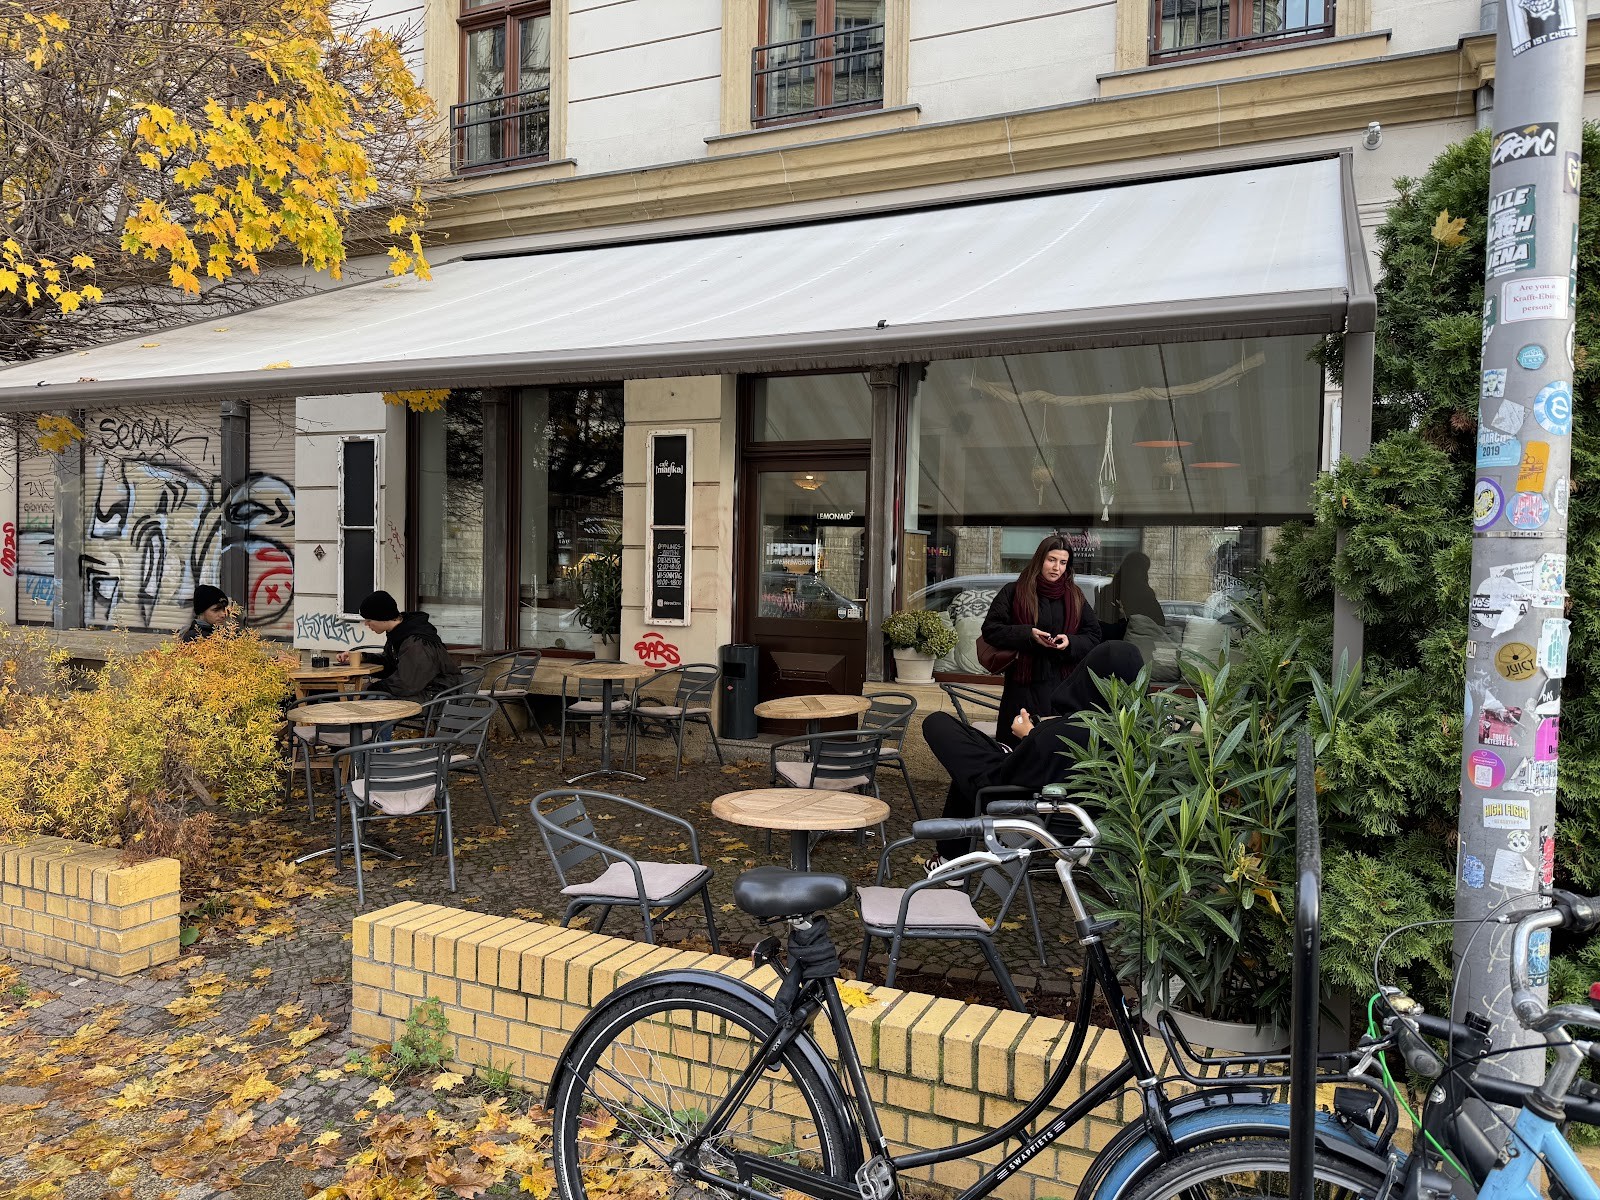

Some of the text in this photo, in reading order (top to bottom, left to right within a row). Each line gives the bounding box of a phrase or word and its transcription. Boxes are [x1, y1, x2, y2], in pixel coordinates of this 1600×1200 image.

[1513, 41, 1531, 56] HIER
[1533, 35, 1547, 45] IST
[1487, 243, 1529, 271] JENA
[1522, 304, 1552, 313] person?
[1482, 445, 1500, 457] 2019
[1543, 691, 1553, 701] DAS
[1485, 803, 1529, 820] HIGH FIGHT
[1009, 1131, 1054, 1170] SWAPFIETS
